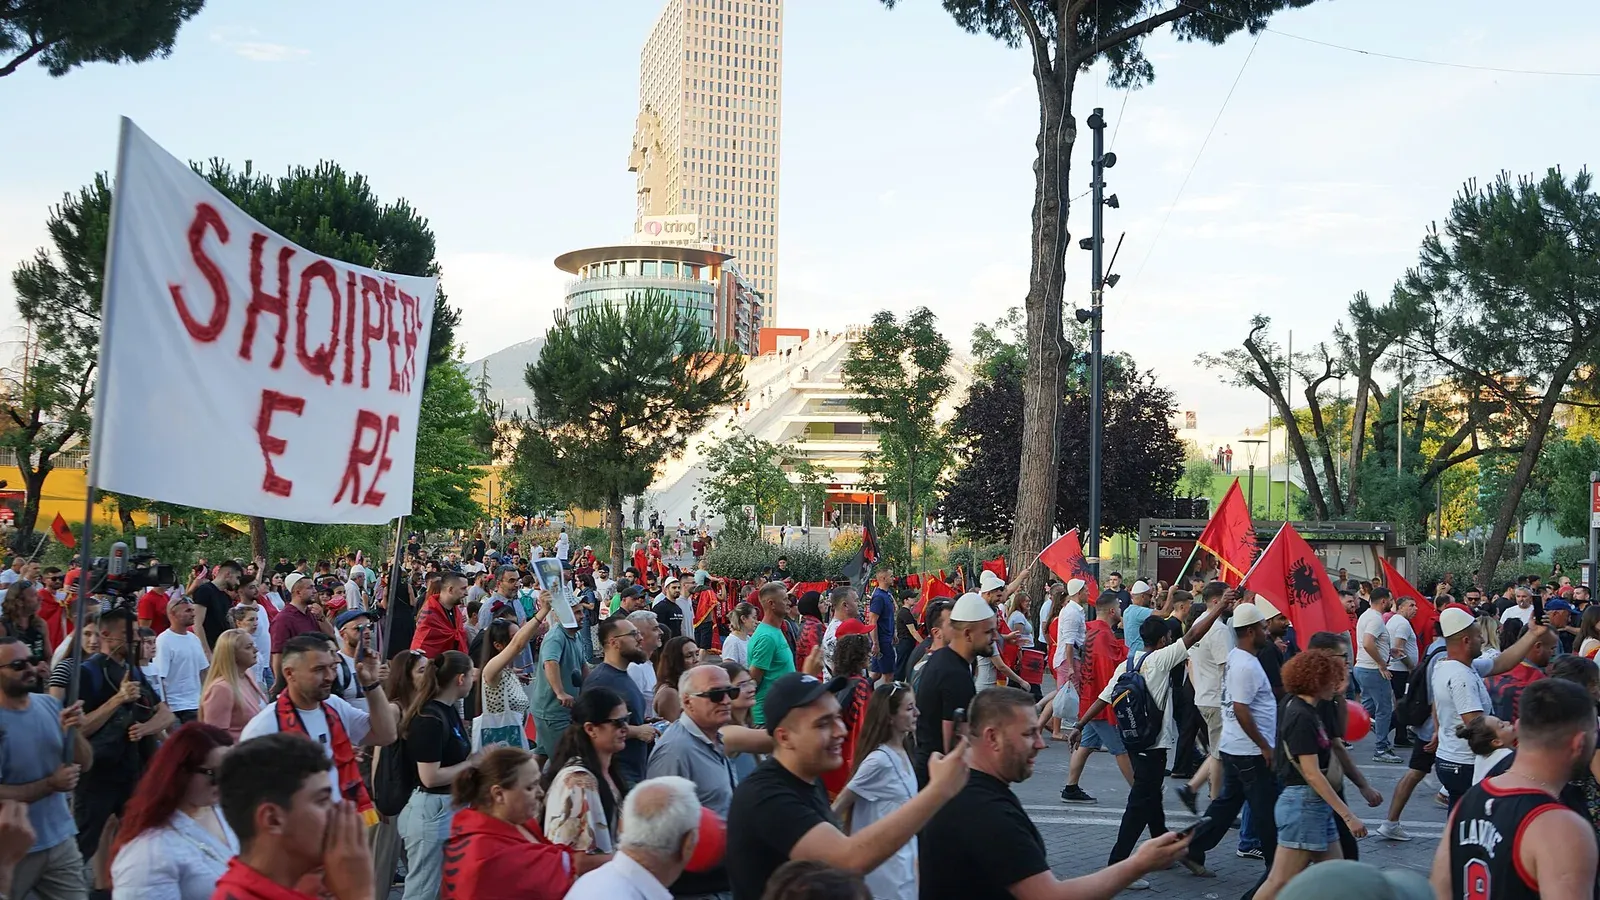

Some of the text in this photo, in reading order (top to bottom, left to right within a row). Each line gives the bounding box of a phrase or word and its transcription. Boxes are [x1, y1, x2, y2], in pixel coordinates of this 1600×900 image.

[664, 219, 696, 236] tring
[256, 388, 399, 508] E RE
